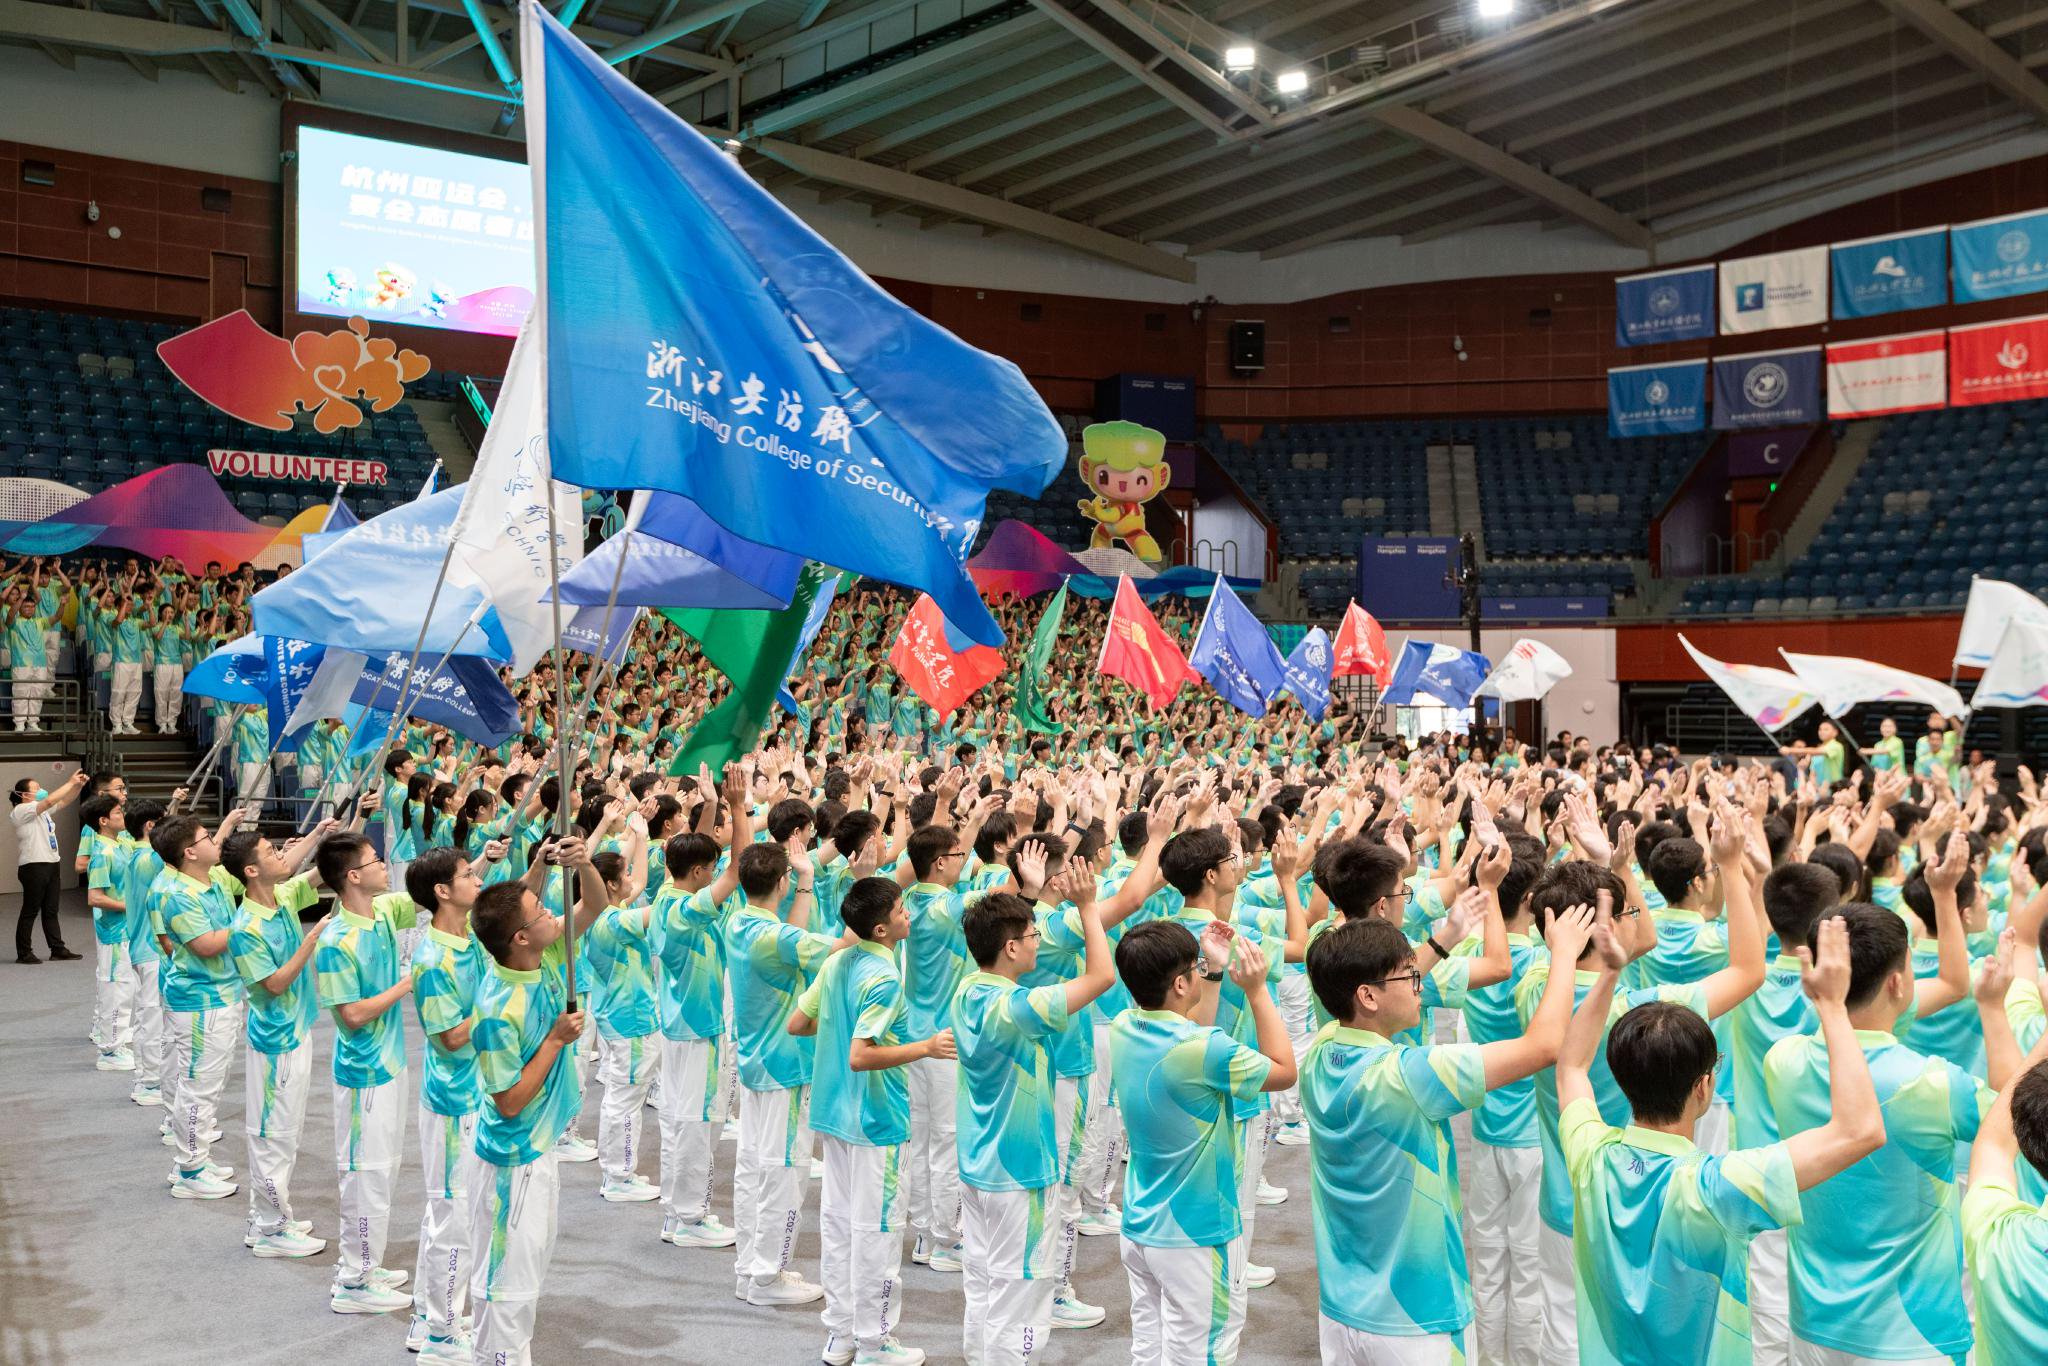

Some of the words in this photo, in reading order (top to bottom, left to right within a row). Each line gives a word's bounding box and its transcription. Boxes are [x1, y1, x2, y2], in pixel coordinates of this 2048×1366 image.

[646, 386, 731, 443] Zhejiang
[736, 425, 812, 470] College
[816, 458, 845, 478] of
[1764, 443, 1779, 465] C
[208, 450, 388, 485] VOLUNTEER
[911, 645, 930, 669] Police
[278, 662, 286, 675] OF
[361, 672, 401, 691] OCATONAL
[188, 1105, 198, 1126] 2022
[624, 1114, 632, 1132] 2022
[1106, 1141, 1116, 1162] 2022
[359, 1216, 368, 1237] 2022
[785, 1210, 797, 1232] 2022
[448, 1248, 459, 1272] 2022
[447, 1275, 456, 1326] Hangzhou
[1023, 1326, 1034, 1357] 2022
